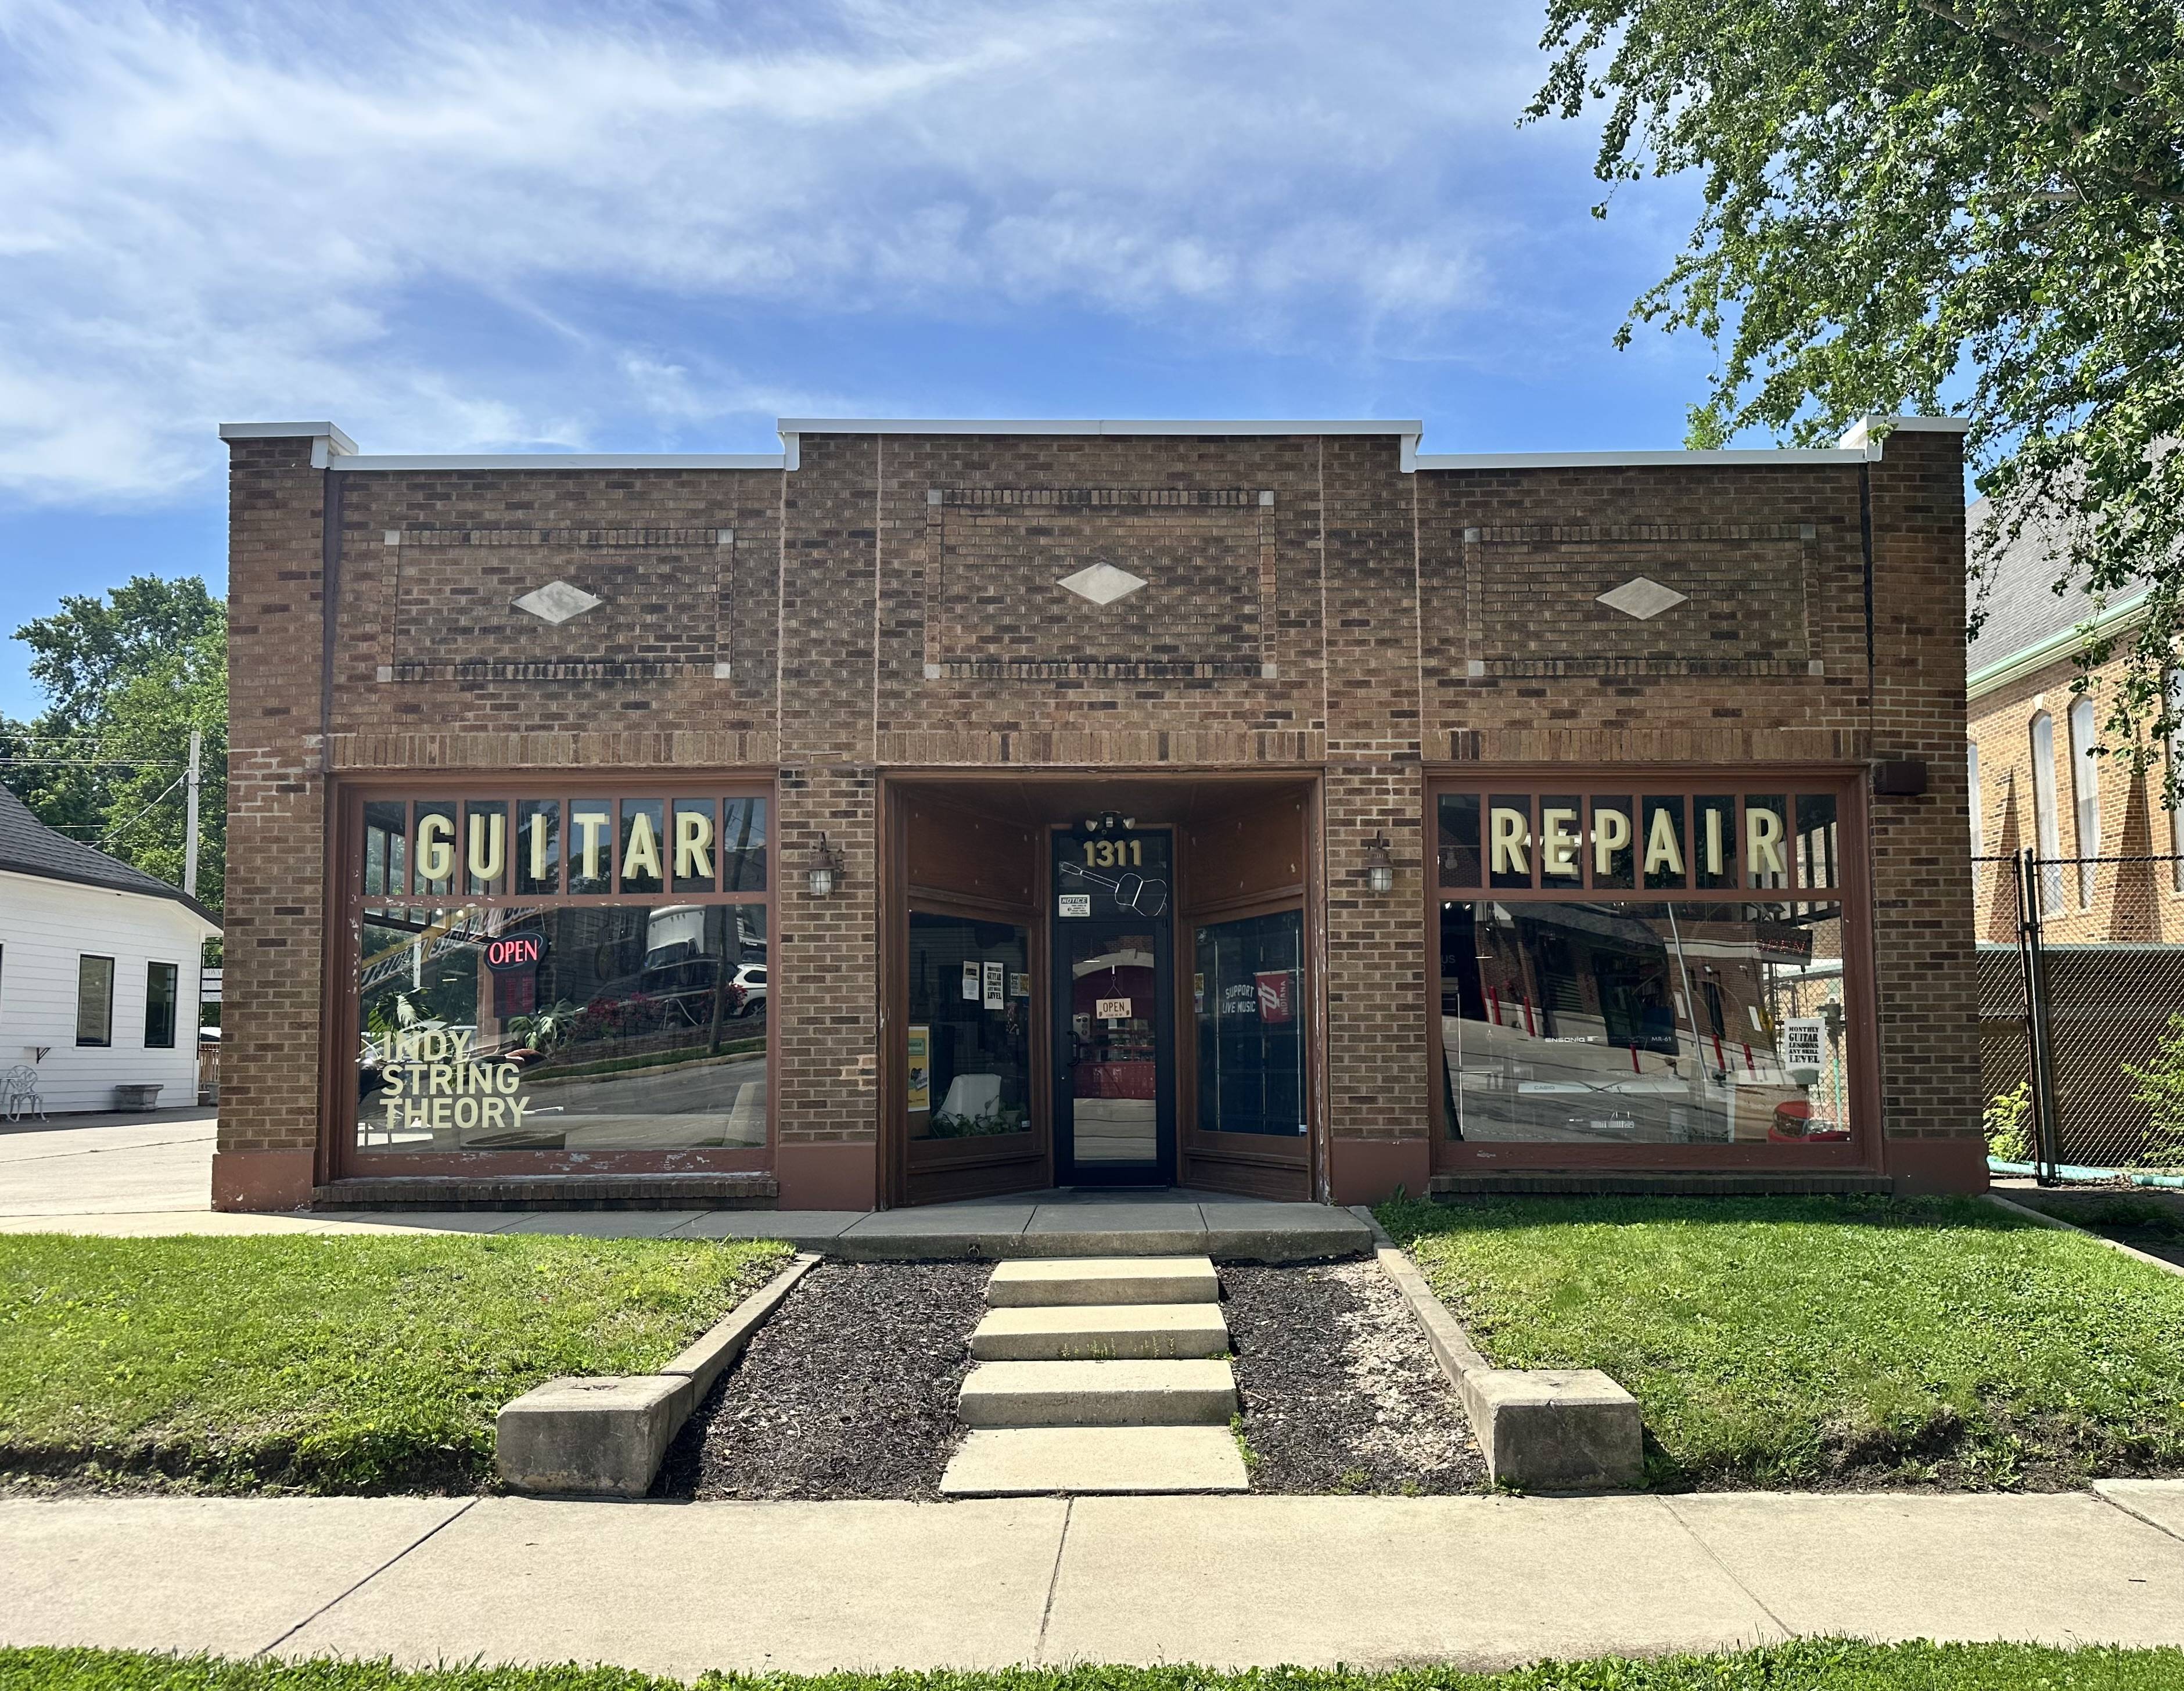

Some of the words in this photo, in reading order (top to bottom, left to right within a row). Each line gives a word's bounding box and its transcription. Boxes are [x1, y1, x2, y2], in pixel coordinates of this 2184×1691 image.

[417, 812, 714, 880] GUITAR
[1083, 840, 1142, 868] 1311
[1490, 807, 1787, 876] REPAIR
[489, 939, 538, 965] OPEN
[1225, 984, 1255, 999] SUPPORT
[1280, 980, 1289, 1016] INDIANA
[1103, 1002, 1125, 1012] OPEN
[1223, 1002, 1236, 1013] LIVE
[1237, 1001, 1256, 1012] MUSIC
[383, 1030, 472, 1062] INDY
[1788, 1033, 1819, 1042] GUITAR
[1789, 1055, 1820, 1063] LEVEL
[380, 1062, 520, 1096] STRING
[379, 1096, 530, 1129] THEORY
